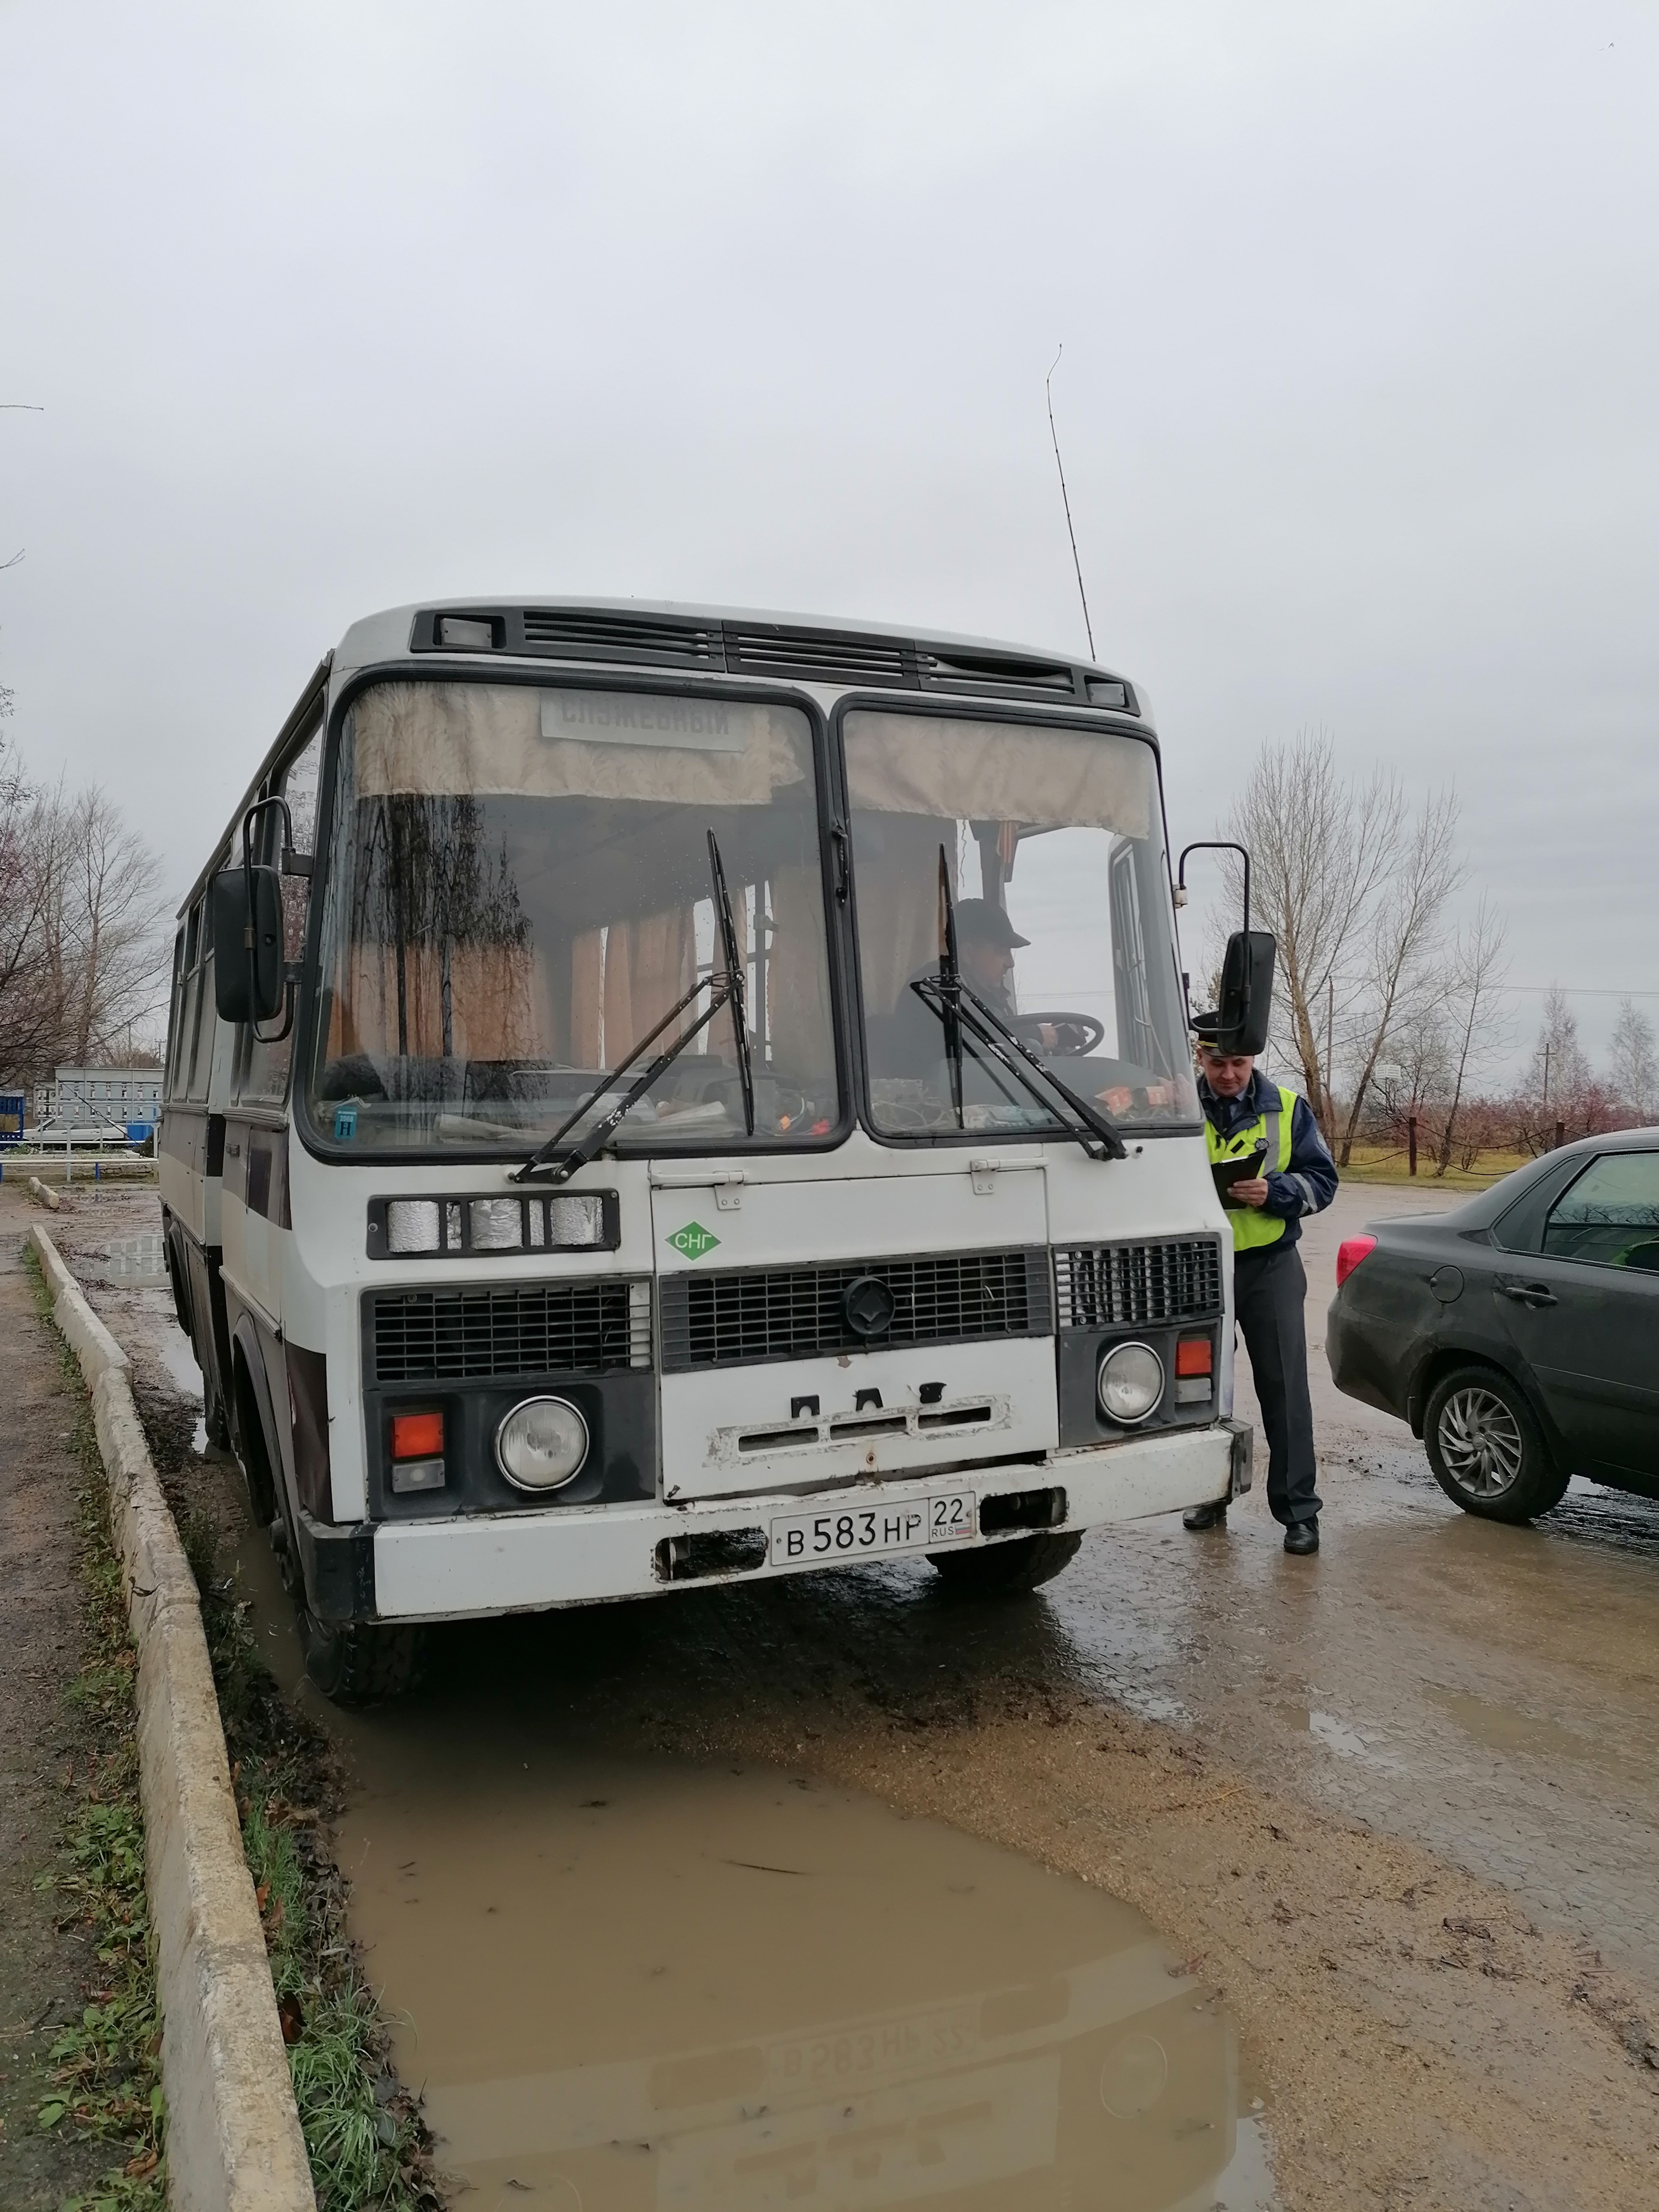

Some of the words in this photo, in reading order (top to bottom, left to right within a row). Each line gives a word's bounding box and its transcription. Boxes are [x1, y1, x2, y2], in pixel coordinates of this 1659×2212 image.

[675, 1233, 712, 1249] СНГ
[933, 1498, 963, 1526] 22
[931, 1525, 954, 1538] RUS
